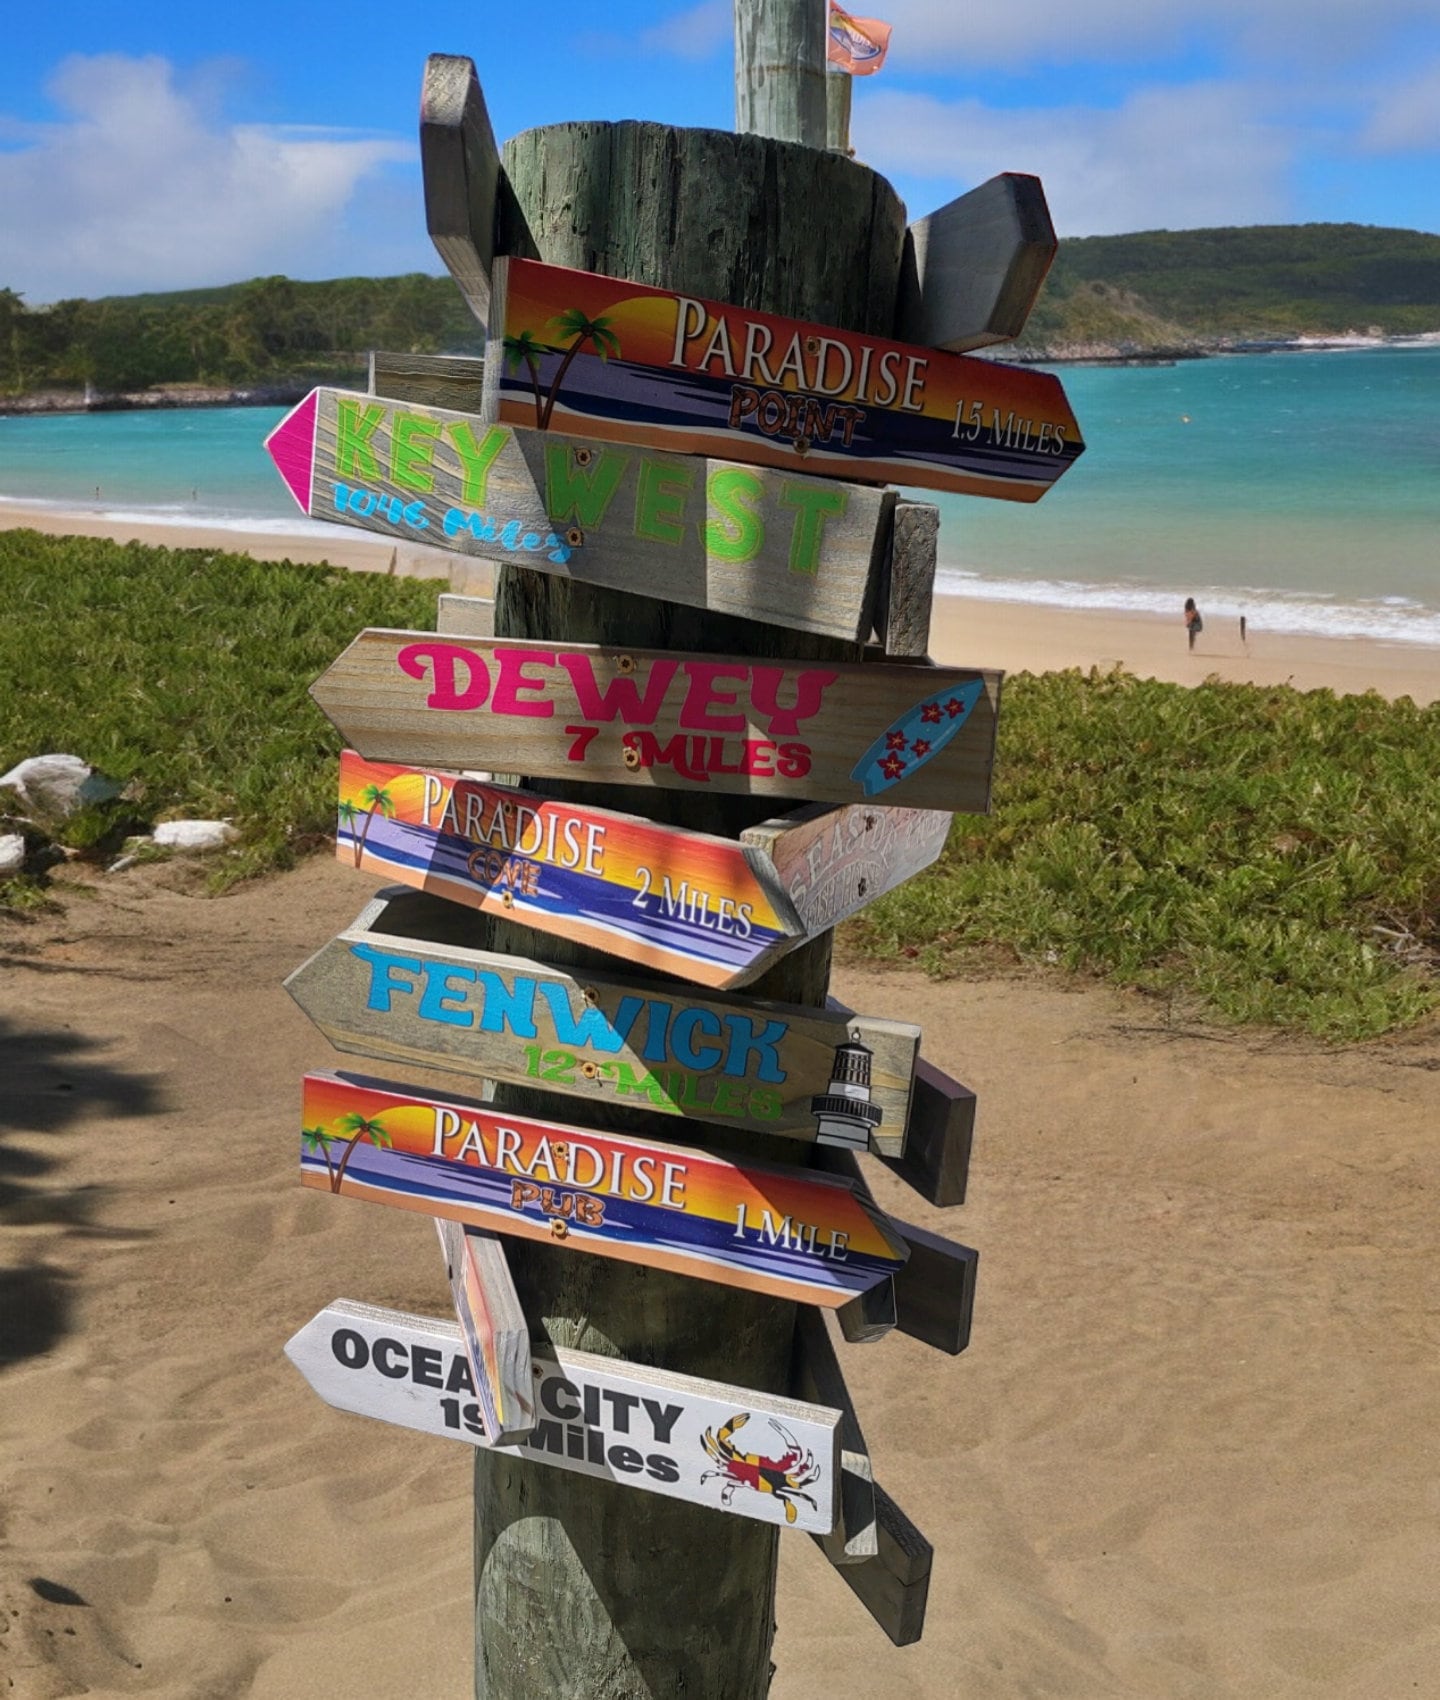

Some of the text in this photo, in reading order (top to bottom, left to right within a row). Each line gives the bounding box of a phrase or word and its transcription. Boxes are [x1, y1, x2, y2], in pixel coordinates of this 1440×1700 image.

[667, 295, 928, 413] PARADISE
[727, 384, 867, 446] POINT
[951, 400, 1068, 456] 1.5 MILES
[330, 482, 574, 564] 1046 Miles
[334, 399, 849, 576] KEY WEST
[398, 643, 839, 736] DEWEY
[564, 725, 812, 782] 7 MILES
[421, 774, 607, 877] PARADISE
[467, 848, 542, 897] COVE
[631, 867, 650, 910] 2
[660, 877, 754, 939] MILES
[350, 942, 789, 1084] FENWICK
[524, 1045, 785, 1121] 12 MILES
[430, 1106, 689, 1210] PARADISE
[510, 1180, 606, 1228] PUB
[732, 1203, 851, 1262] 1 MILE
[331, 1328, 684, 1443] OCEA CITY
